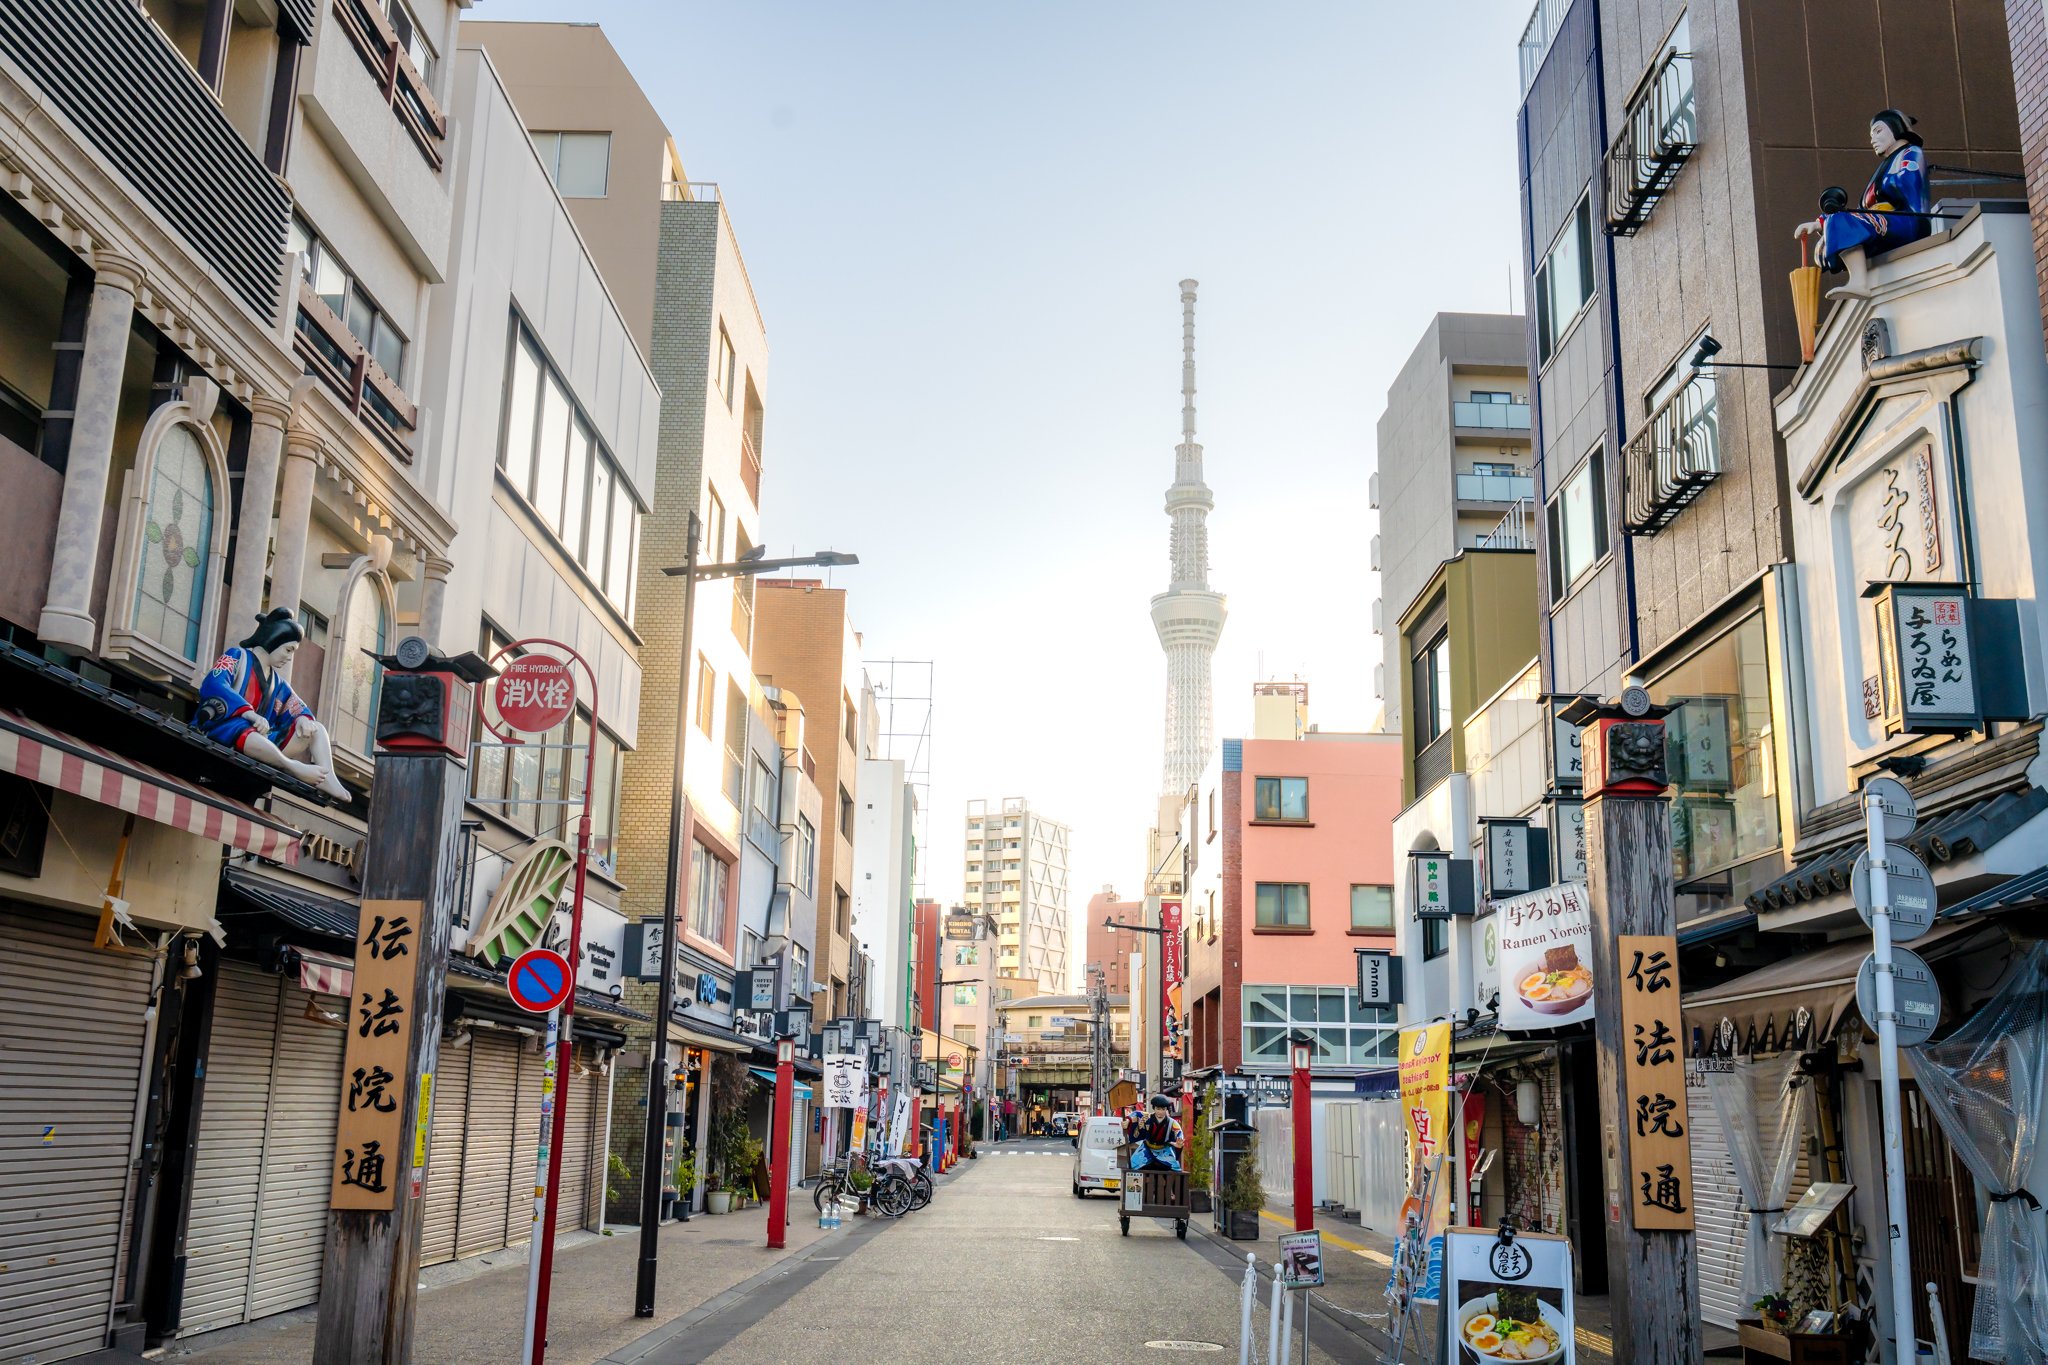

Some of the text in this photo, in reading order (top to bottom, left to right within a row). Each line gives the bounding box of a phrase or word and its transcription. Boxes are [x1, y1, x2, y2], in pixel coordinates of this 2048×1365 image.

[510, 664, 564, 674] FIRE HYDRANT
[1905, 606, 1940, 706] 与ろゐ屋
[1940, 628, 1963, 683] らめん
[501, 678, 570, 709] 消火栓
[1420, 903, 1447, 912] ヴェニス
[1507, 890, 1582, 928] 与ろゐ屋
[1502, 933, 1548, 951] Ramen
[341, 914, 413, 1194] 伝法院通
[1627, 950, 1688, 1214] 伝法院通
